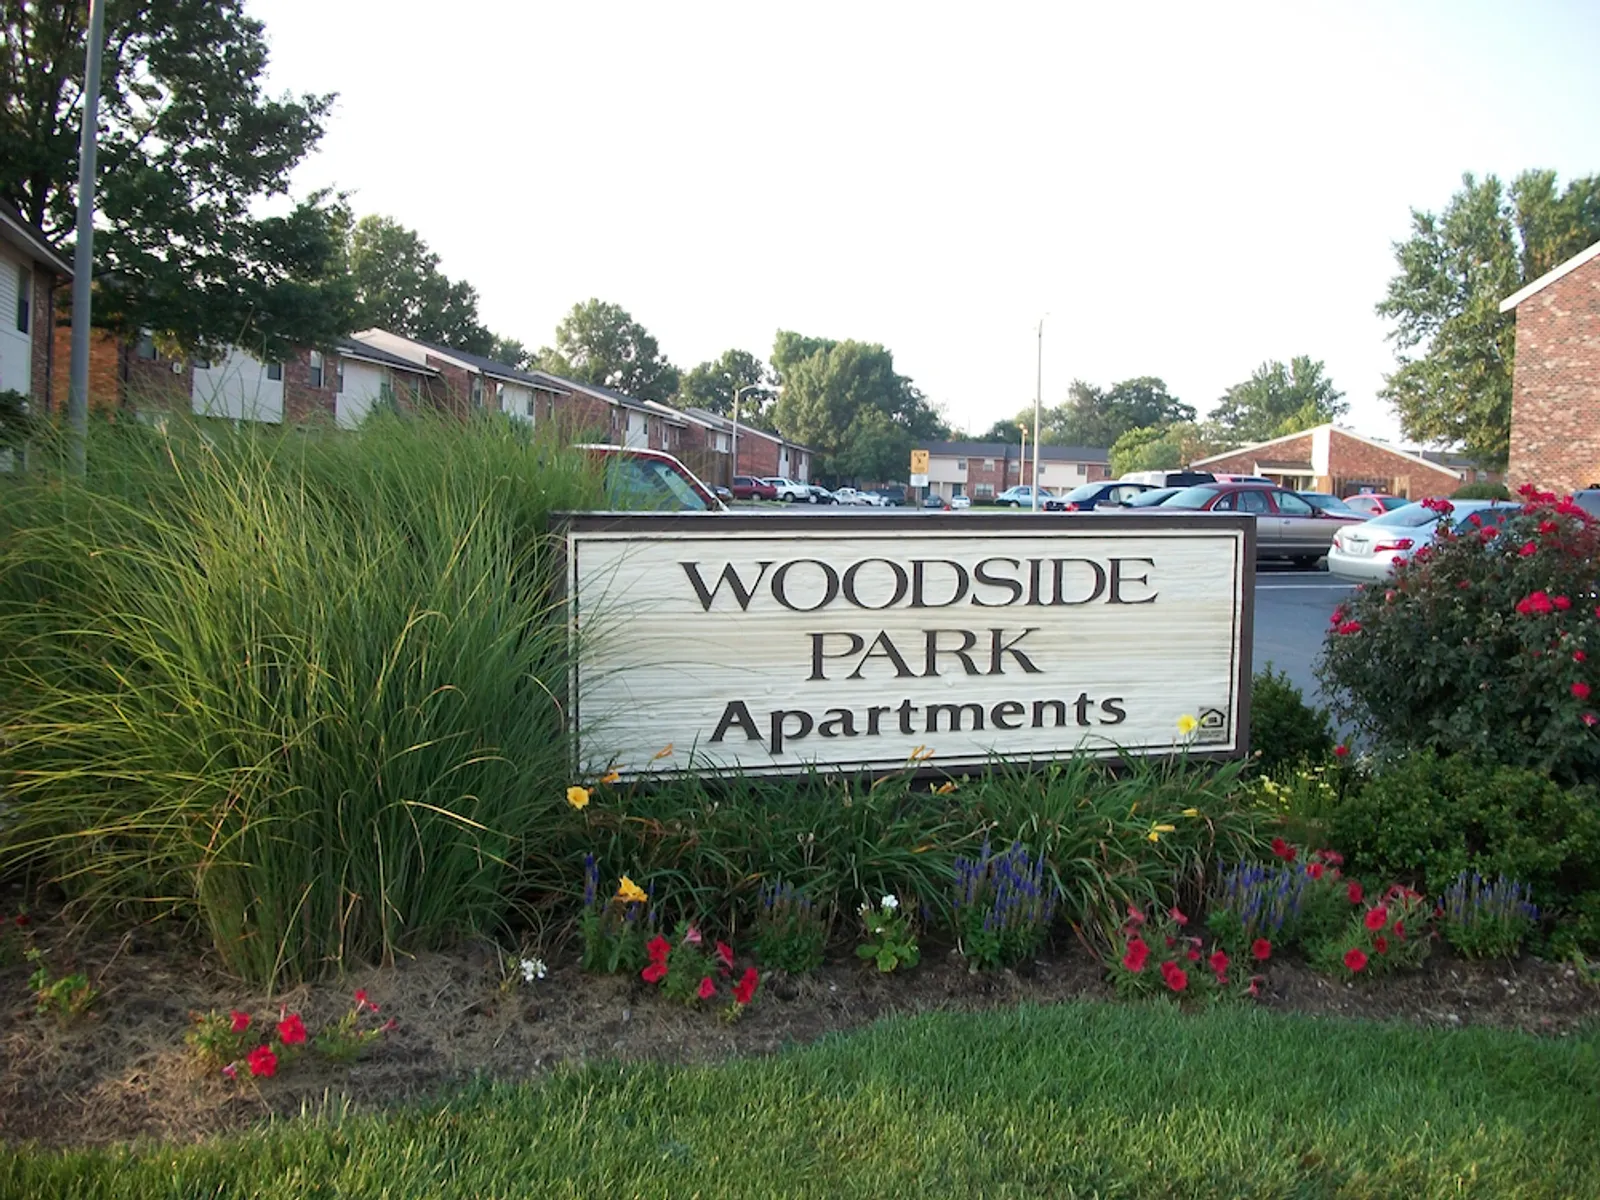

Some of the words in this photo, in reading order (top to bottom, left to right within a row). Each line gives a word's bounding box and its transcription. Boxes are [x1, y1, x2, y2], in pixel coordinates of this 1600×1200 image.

[679, 557, 1158, 613] WOODSIDE
[805, 627, 1044, 681] PARK
[708, 693, 1127, 756] Apartments
